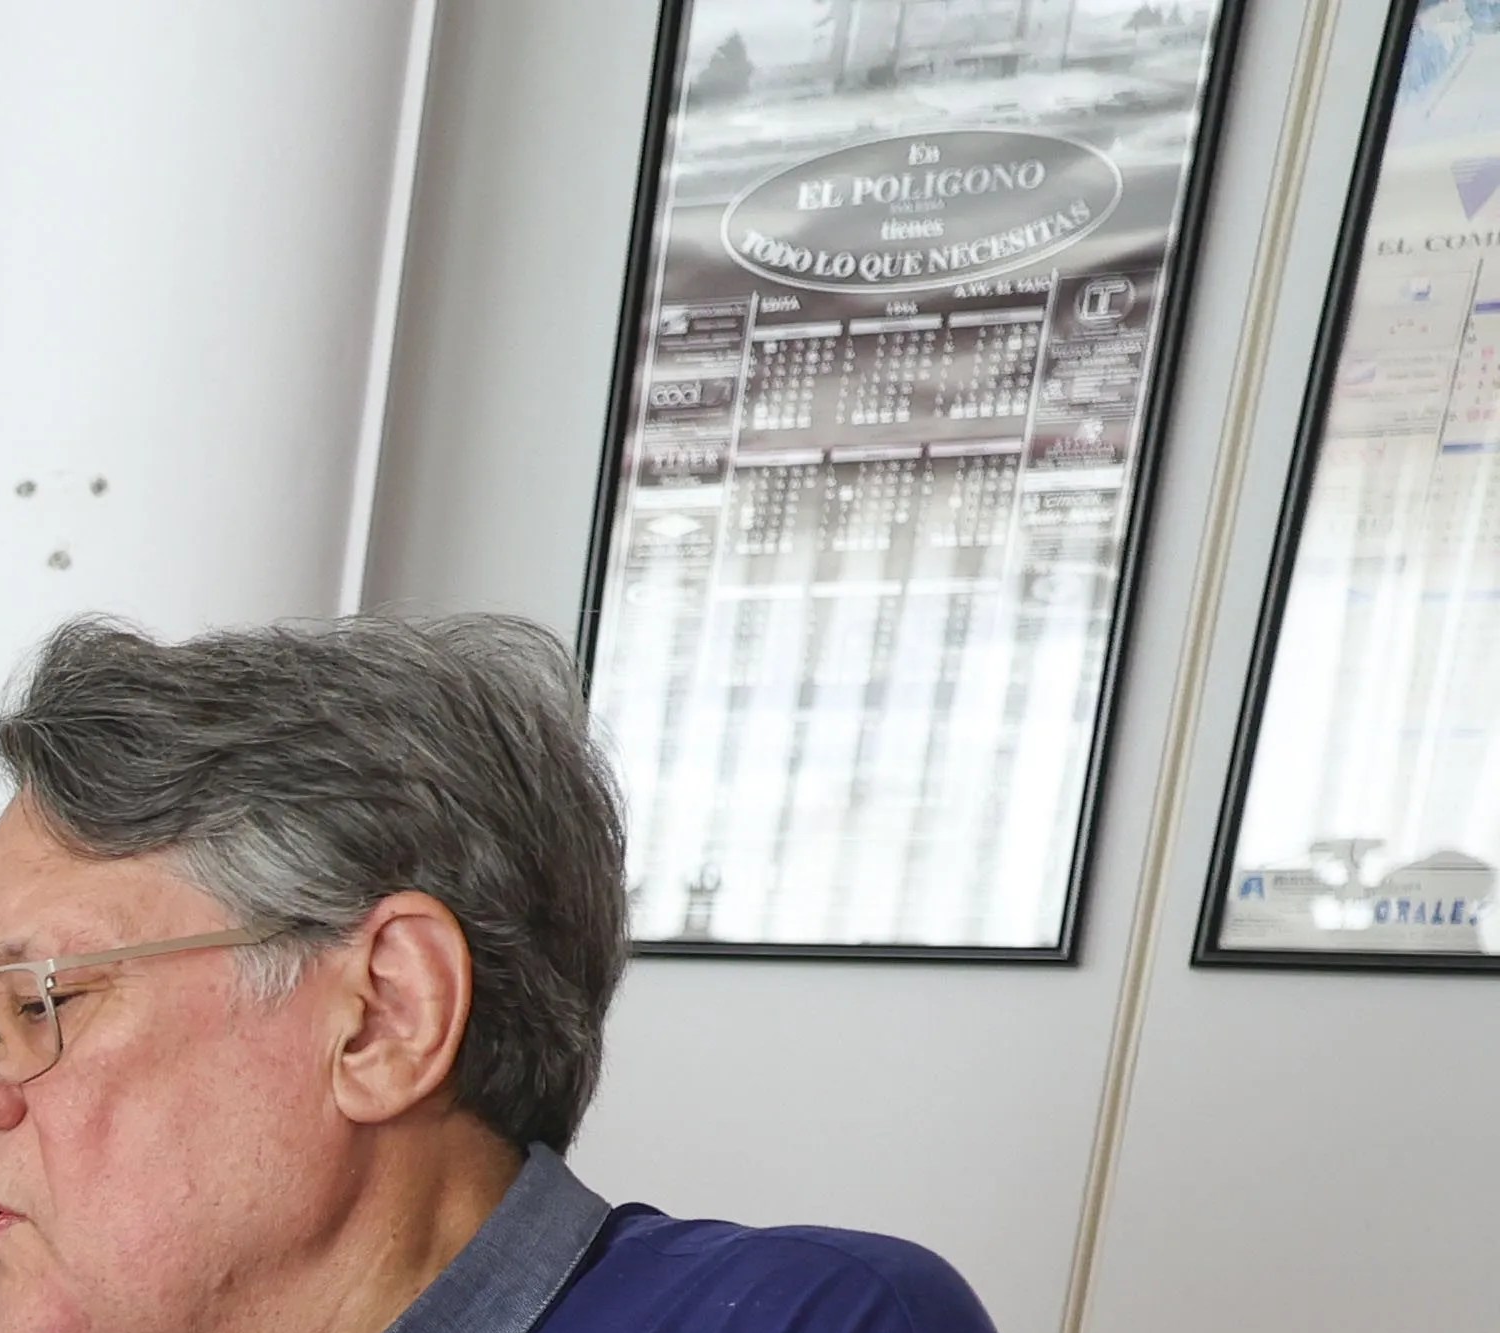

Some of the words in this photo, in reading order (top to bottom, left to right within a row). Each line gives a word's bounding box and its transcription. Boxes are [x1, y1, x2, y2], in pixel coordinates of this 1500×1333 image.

[798, 180, 842, 210] EL
[740, 229, 812, 274] TODO
[815, 250, 856, 278] LO
[859, 250, 922, 281] QUE
[928, 199, 1091, 274] NECESITAS
